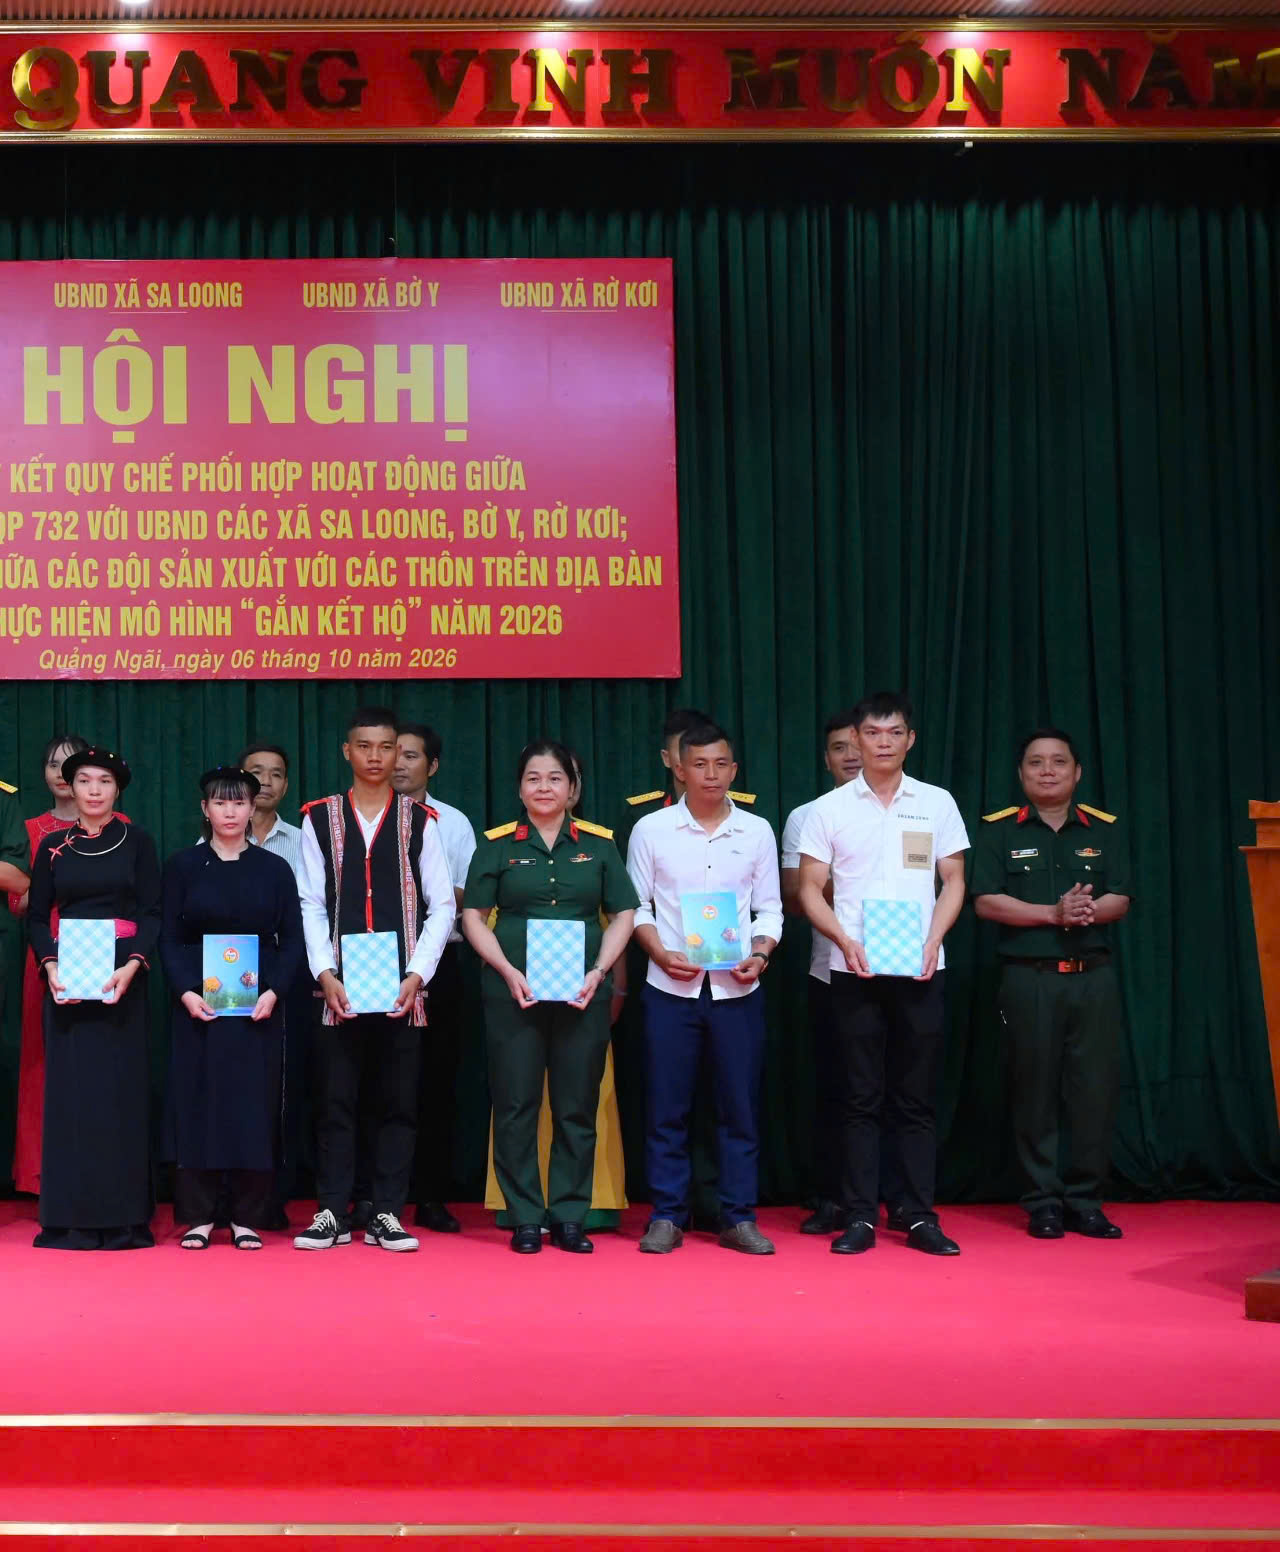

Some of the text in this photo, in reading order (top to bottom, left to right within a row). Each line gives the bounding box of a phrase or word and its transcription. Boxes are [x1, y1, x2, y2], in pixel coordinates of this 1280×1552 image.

[11, 46, 368, 131] QUANG
[412, 48, 671, 113] VINH
[54, 277, 243, 308] UBND XÃ SA LOONG
[303, 275, 440, 308] UBND XÃ BỜ Y
[500, 275, 658, 308] UBND XÃ RỜ KƠI
[23, 327, 469, 444] HỘI NGHỊ
[10, 453, 57, 495] KẾT
[65, 461, 115, 497] QUY
[123, 452, 174, 493] CHẾ
[182, 451, 242, 493] PHỐI
[251, 459, 303, 499] HỢP
[311, 459, 377, 499] HOẠT
[385, 454, 457, 498] ĐỘNG
[465, 455, 527, 492] GIỮA
[32, 510, 79, 542] 732
[87, 503, 128, 542] VỚI
[137, 509, 208, 541] UBND
[216, 503, 269, 541] CÁC
[277, 503, 312, 540] XÃ
[320, 507, 354, 540] SA
[362, 507, 455, 543] LOONG,
[463, 501, 498, 540] BỜ
[506, 507, 526, 543] Y,
[533, 501, 568, 540] RỜ
[576, 505, 628, 542] KƠI;
[47, 551, 99, 590] CÁC
[107, 551, 150, 595] ĐỘI
[159, 547, 213, 589] SẢN
[221, 546, 288, 588] XUẤT
[296, 549, 337, 588] VỚI
[345, 550, 397, 588] CÁC
[405, 550, 473, 588] THÔN
[482, 550, 548, 587] TRÊN
[556, 554, 601, 594] ĐỊA
[608, 549, 663, 587] BÀN
[51, 599, 112, 644] HIỆN
[120, 599, 162, 638] MÔ
[169, 599, 232, 637] HÌNH
[317, 595, 364, 636] KẾT
[430, 598, 491, 635] NĂM
[499, 604, 563, 635] 2026
[39, 647, 457, 675] Quảng Ngãi, ngày 06 tháng 10 năm 2026
